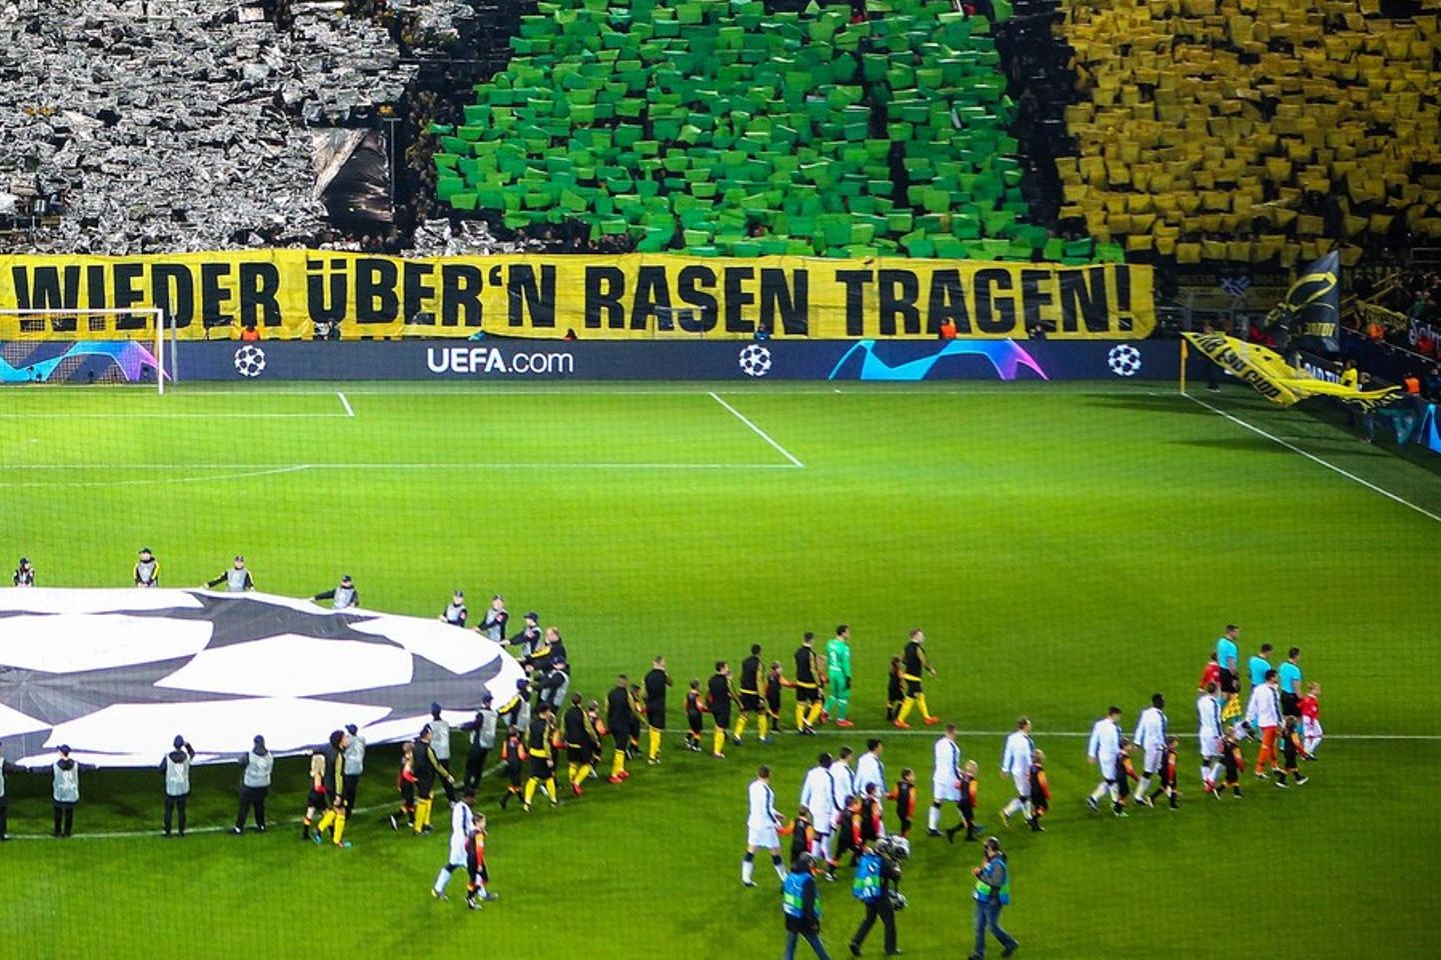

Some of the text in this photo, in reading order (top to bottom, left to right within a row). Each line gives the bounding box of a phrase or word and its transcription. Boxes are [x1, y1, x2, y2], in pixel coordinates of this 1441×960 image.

[12, 262, 282, 331] WIEDER
[584, 265, 809, 338] RASEN
[835, 264, 1134, 337] TRAGEN!
[427, 347, 574, 373] UEFA.com
